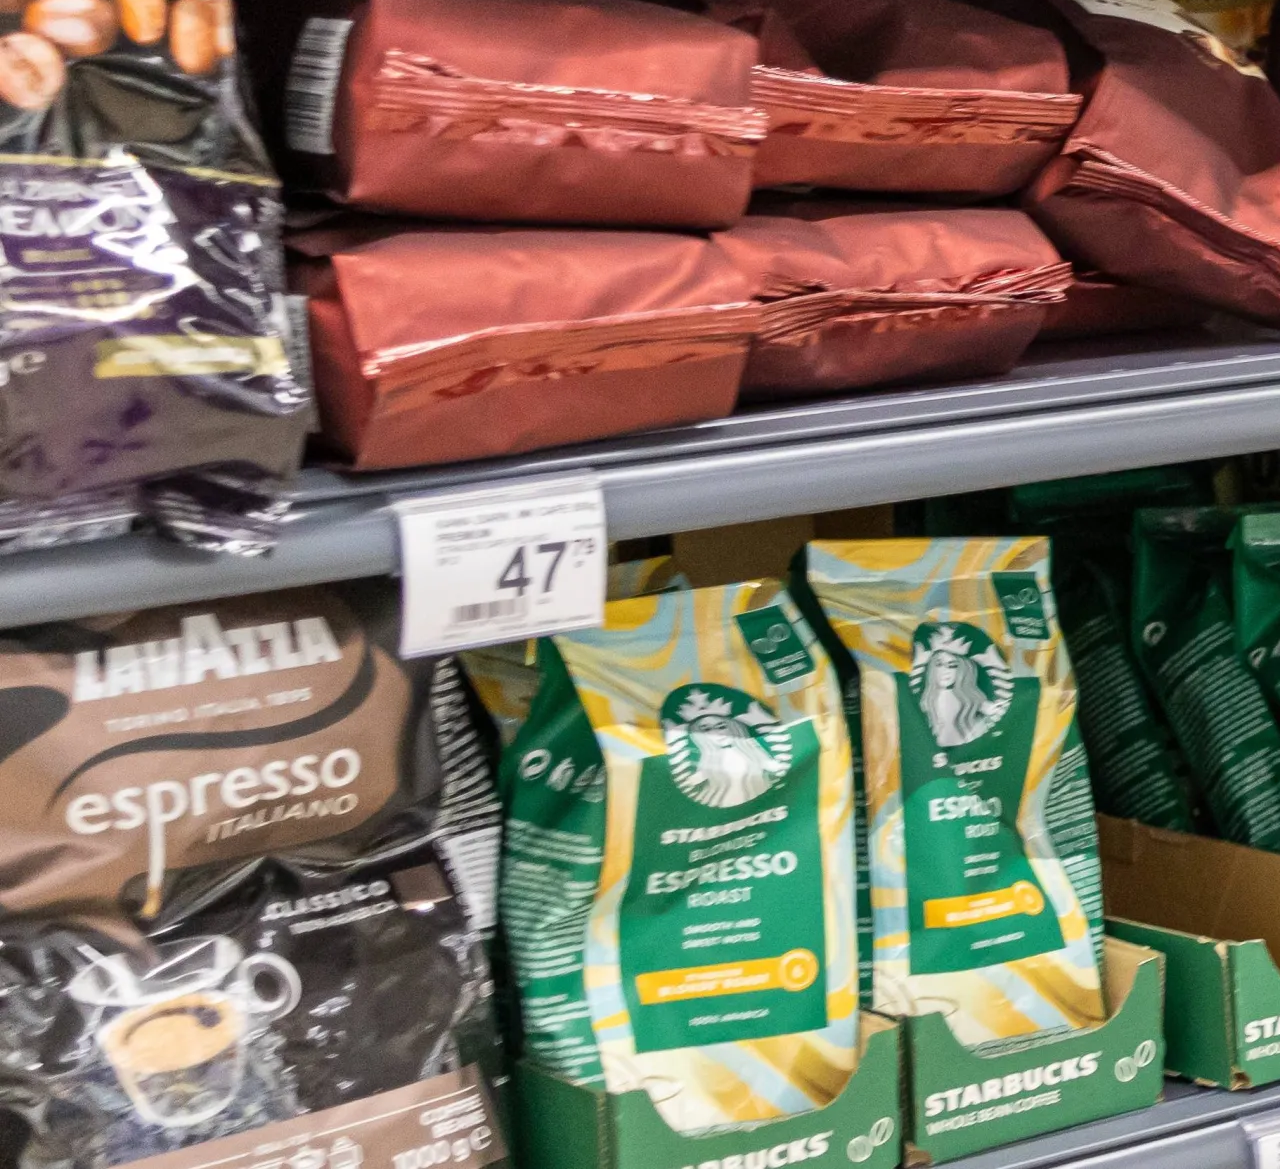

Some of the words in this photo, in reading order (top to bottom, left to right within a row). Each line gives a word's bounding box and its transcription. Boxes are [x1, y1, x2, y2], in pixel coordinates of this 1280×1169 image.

[498, 540, 572, 598] 47
[74, 613, 342, 703] LAVAZZA
[66, 748, 362, 888] espresso
[207, 793, 359, 844] ITALIANO
[660, 805, 789, 845] STARBUCKS
[646, 850, 798, 895] ESPRESSO
[686, 886, 754, 909] ROAST
[262, 879, 392, 921] CLASSICO
[924, 1050, 1103, 1118] STARBUCKS
